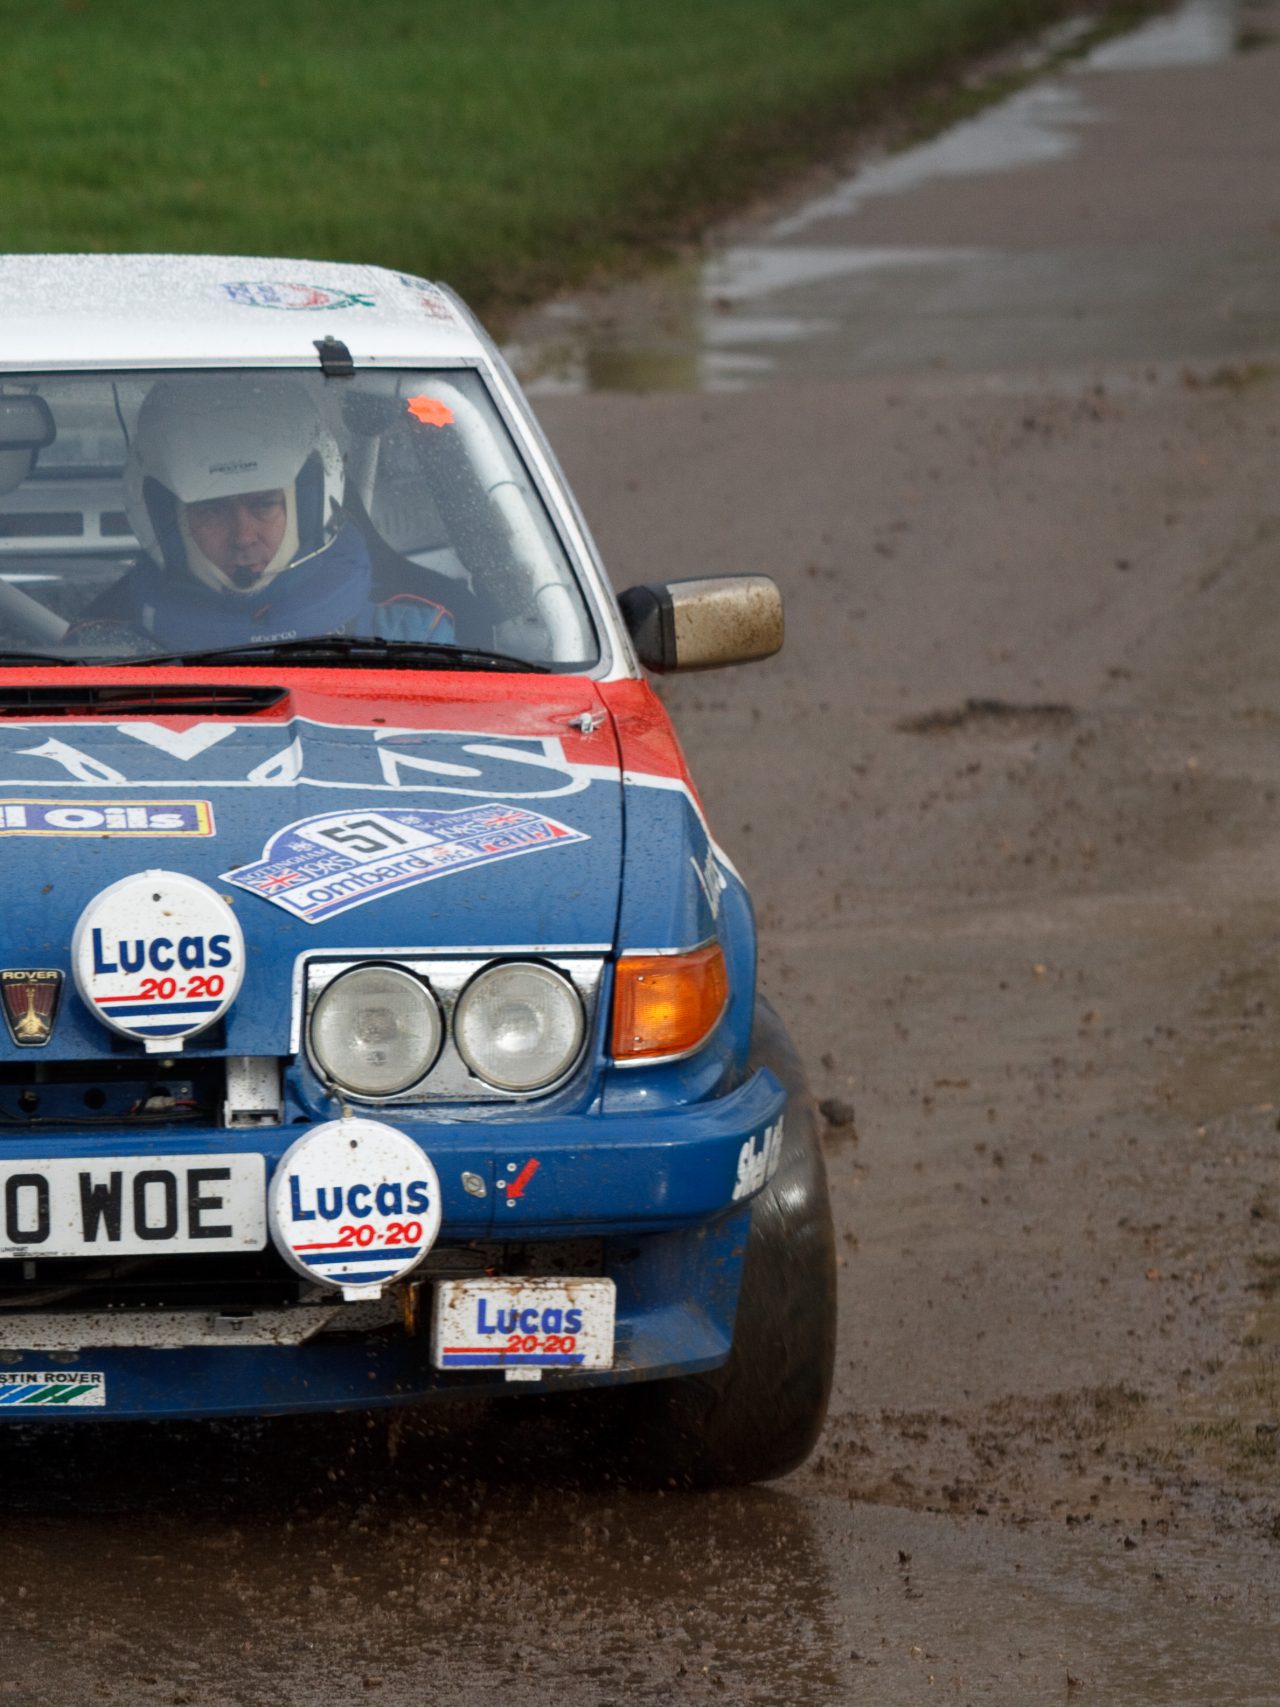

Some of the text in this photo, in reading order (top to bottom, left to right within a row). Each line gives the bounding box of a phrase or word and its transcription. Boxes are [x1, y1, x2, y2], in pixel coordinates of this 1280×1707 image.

[44, 807, 185, 830] Oils
[433, 822, 490, 839] 1985
[318, 819, 408, 853] 57
[239, 848, 335, 882] NOTTINGHAM
[278, 821, 551, 911] Lombard RAC rally
[296, 855, 359, 878] 1985
[92, 927, 232, 974] Lucas
[2, 971, 58, 980] ROVER
[138, 975, 224, 1000] 20-20
[78, 1167, 233, 1242] WOE
[290, 1174, 429, 1222] Lucas
[336, 1221, 423, 1247] 20-20
[477, 1298, 583, 1334] Lucas
[506, 1335, 576, 1354] 20-20
[44, 1373, 102, 1384] ROVER
